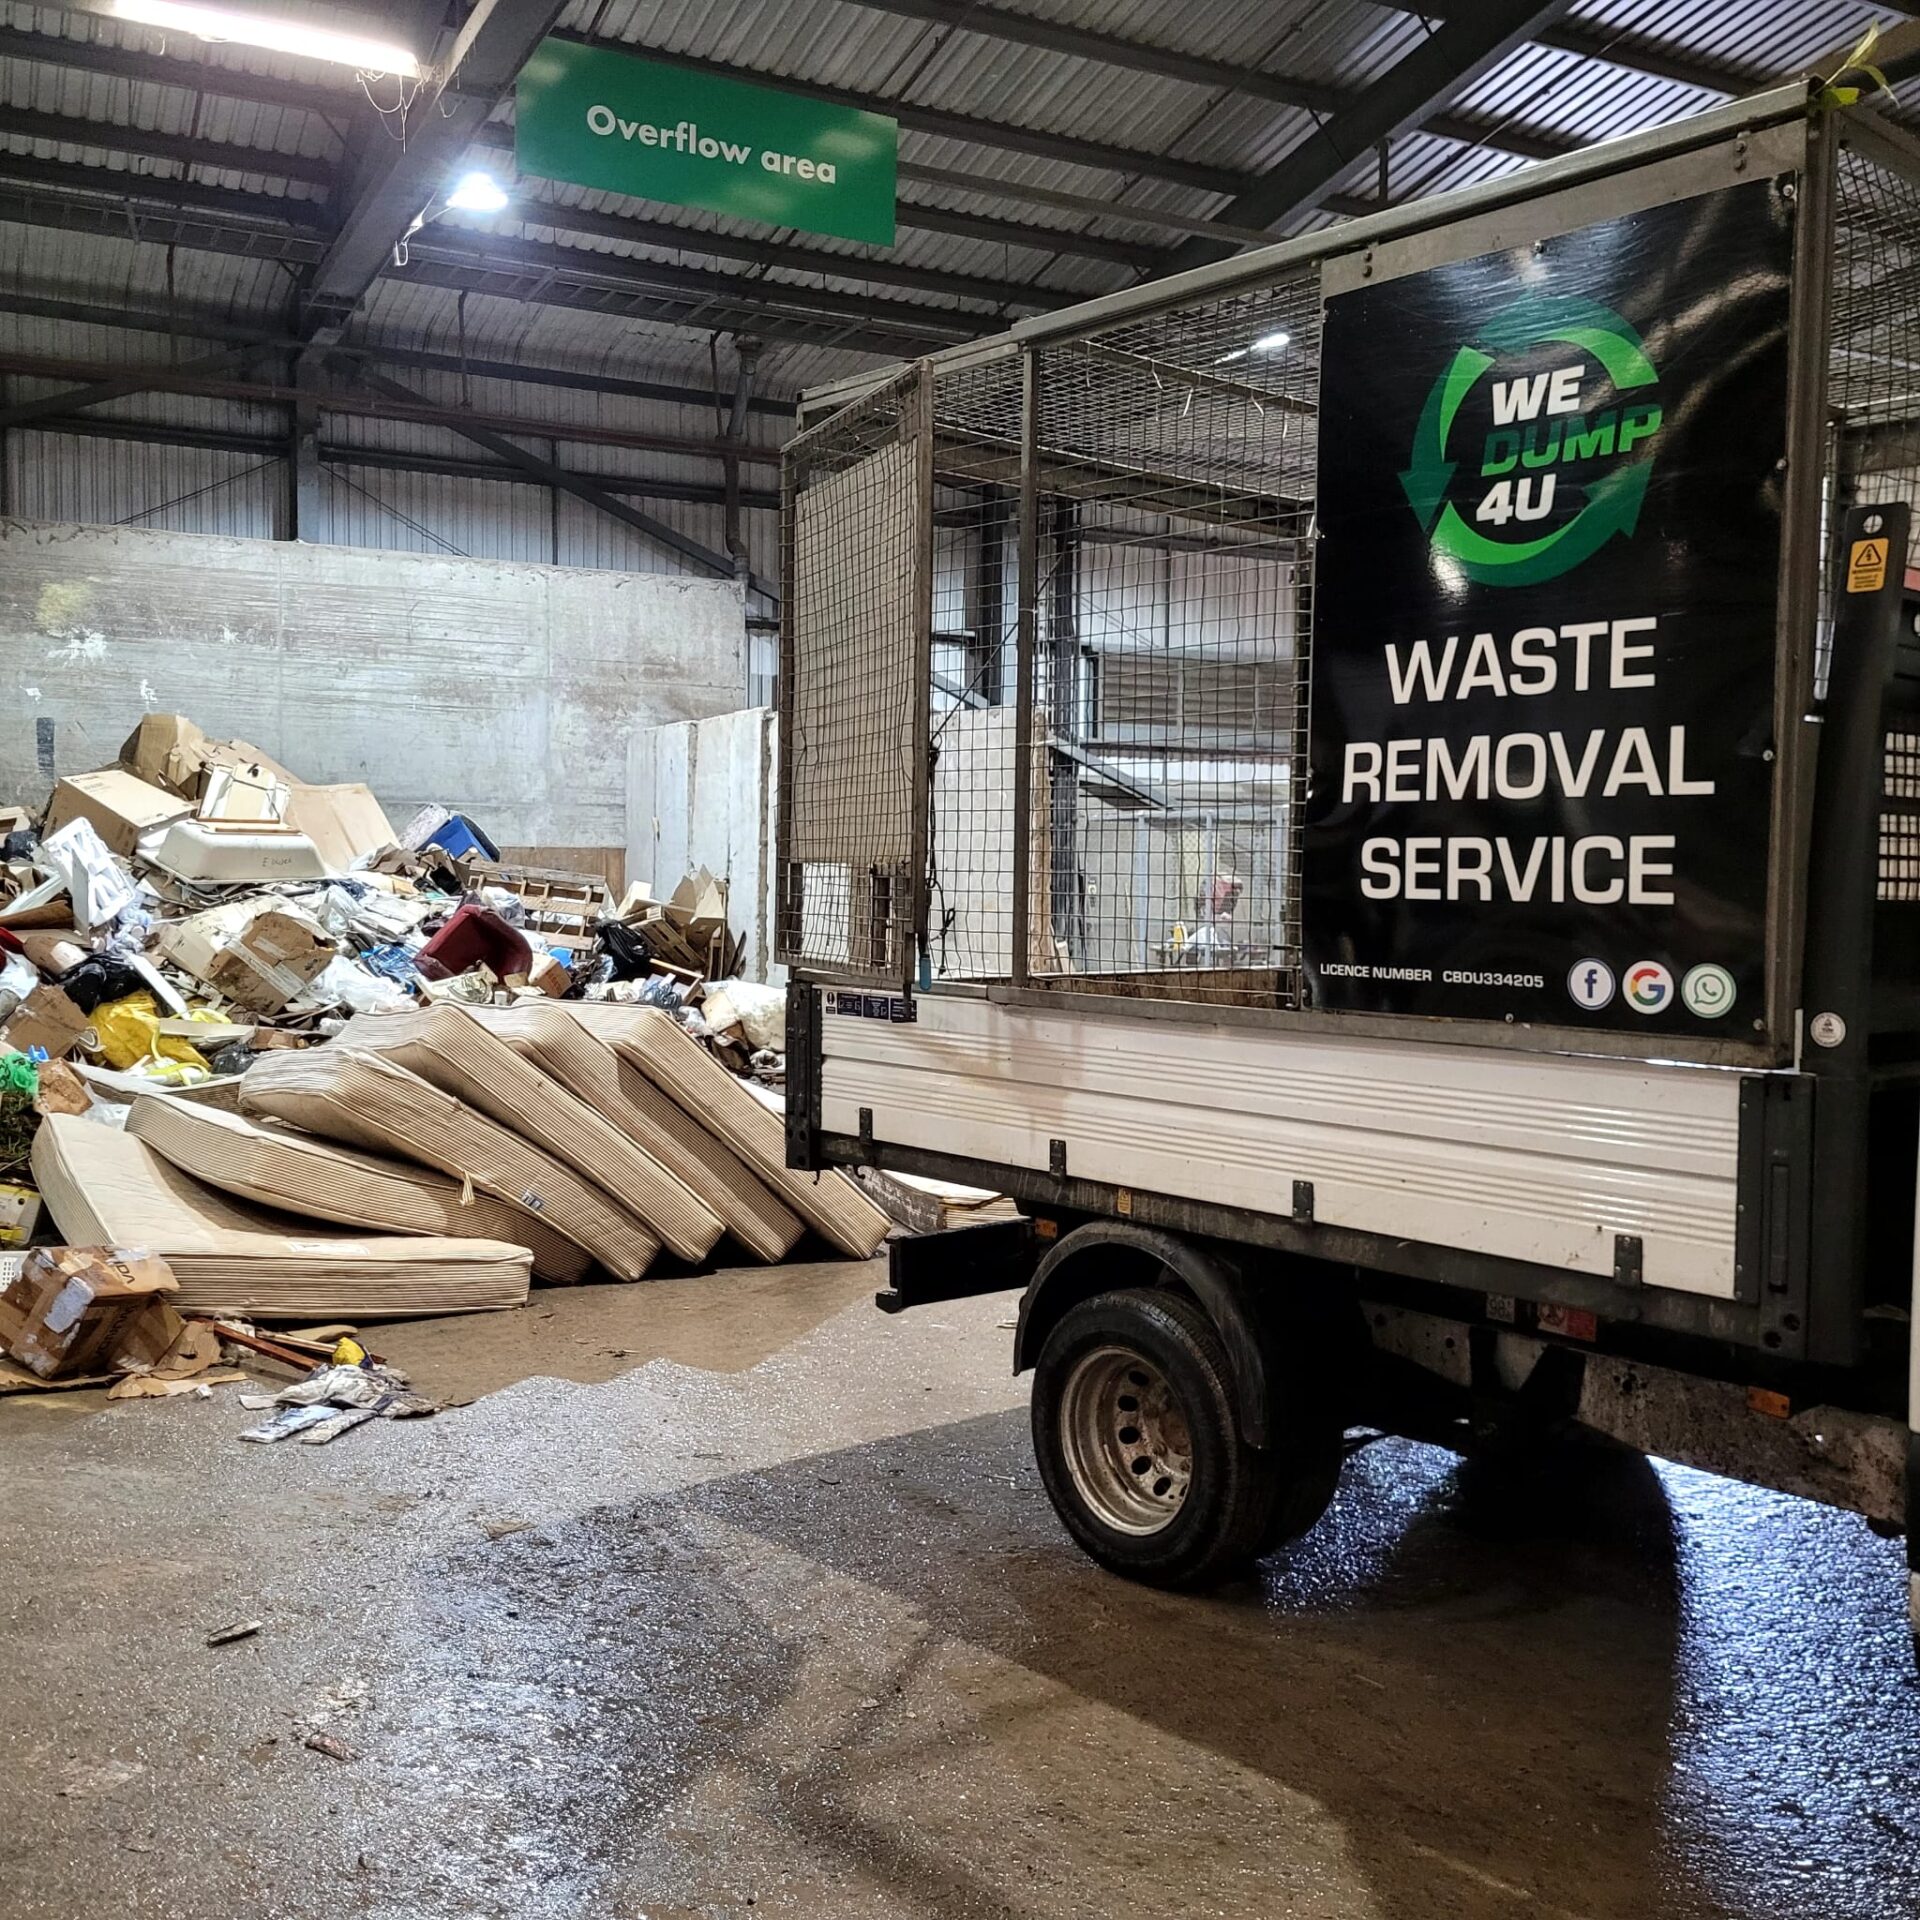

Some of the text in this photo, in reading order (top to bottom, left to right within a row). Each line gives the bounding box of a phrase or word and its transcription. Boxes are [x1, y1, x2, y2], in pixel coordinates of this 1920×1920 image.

[587, 105, 837, 184] Overflow area
[1492, 364, 1585, 426] WE
[1481, 404, 1663, 477] DUMP
[1476, 474, 1557, 526] 4U
[1384, 616, 1657, 704] WASTE
[1342, 725, 1715, 803] REMOVAL
[1360, 835, 1676, 905] SERVICE
[1320, 963, 1544, 988] LICENCE NUMBER CBDU334205
